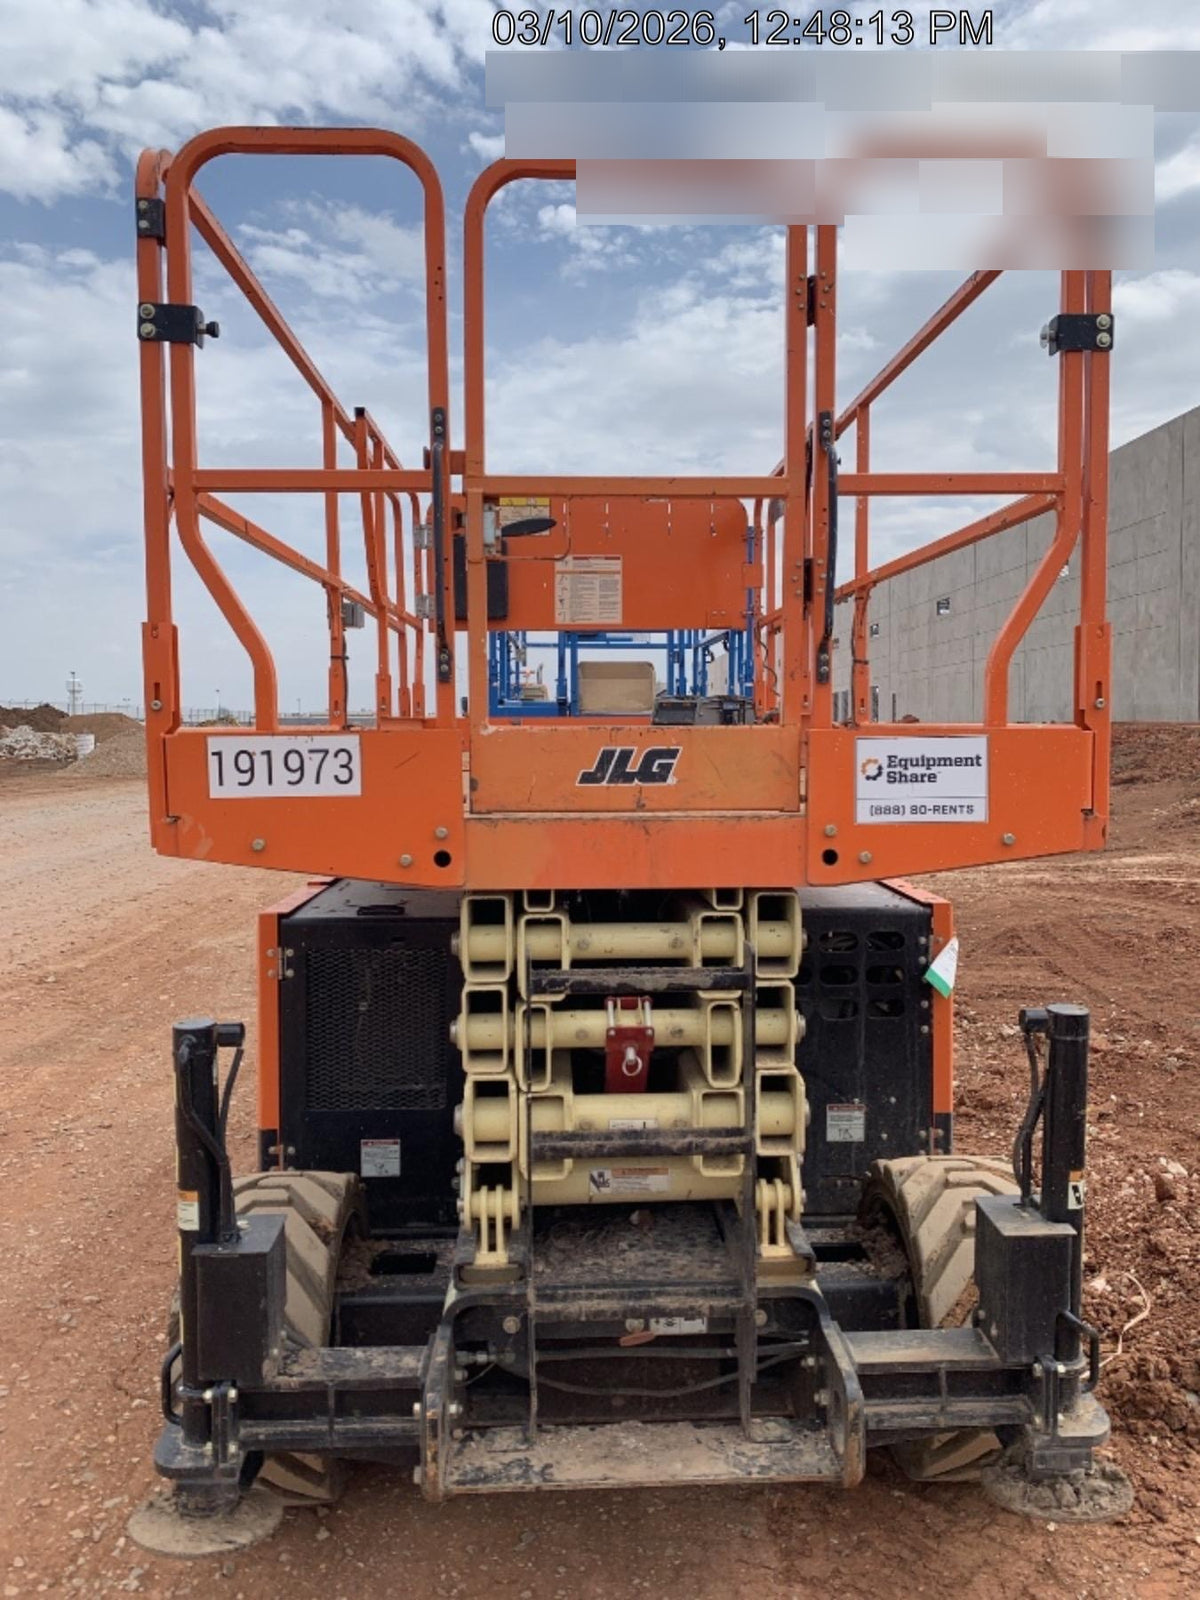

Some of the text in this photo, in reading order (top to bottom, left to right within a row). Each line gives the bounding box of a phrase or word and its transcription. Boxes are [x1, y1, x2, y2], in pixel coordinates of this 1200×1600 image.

[211, 748, 354, 787] 191973
[576, 746, 683, 786] JLG
[886, 754, 983, 771] Equipment
[886, 771, 938, 784] Share
[910, 804, 975, 816] 80-RENTS
